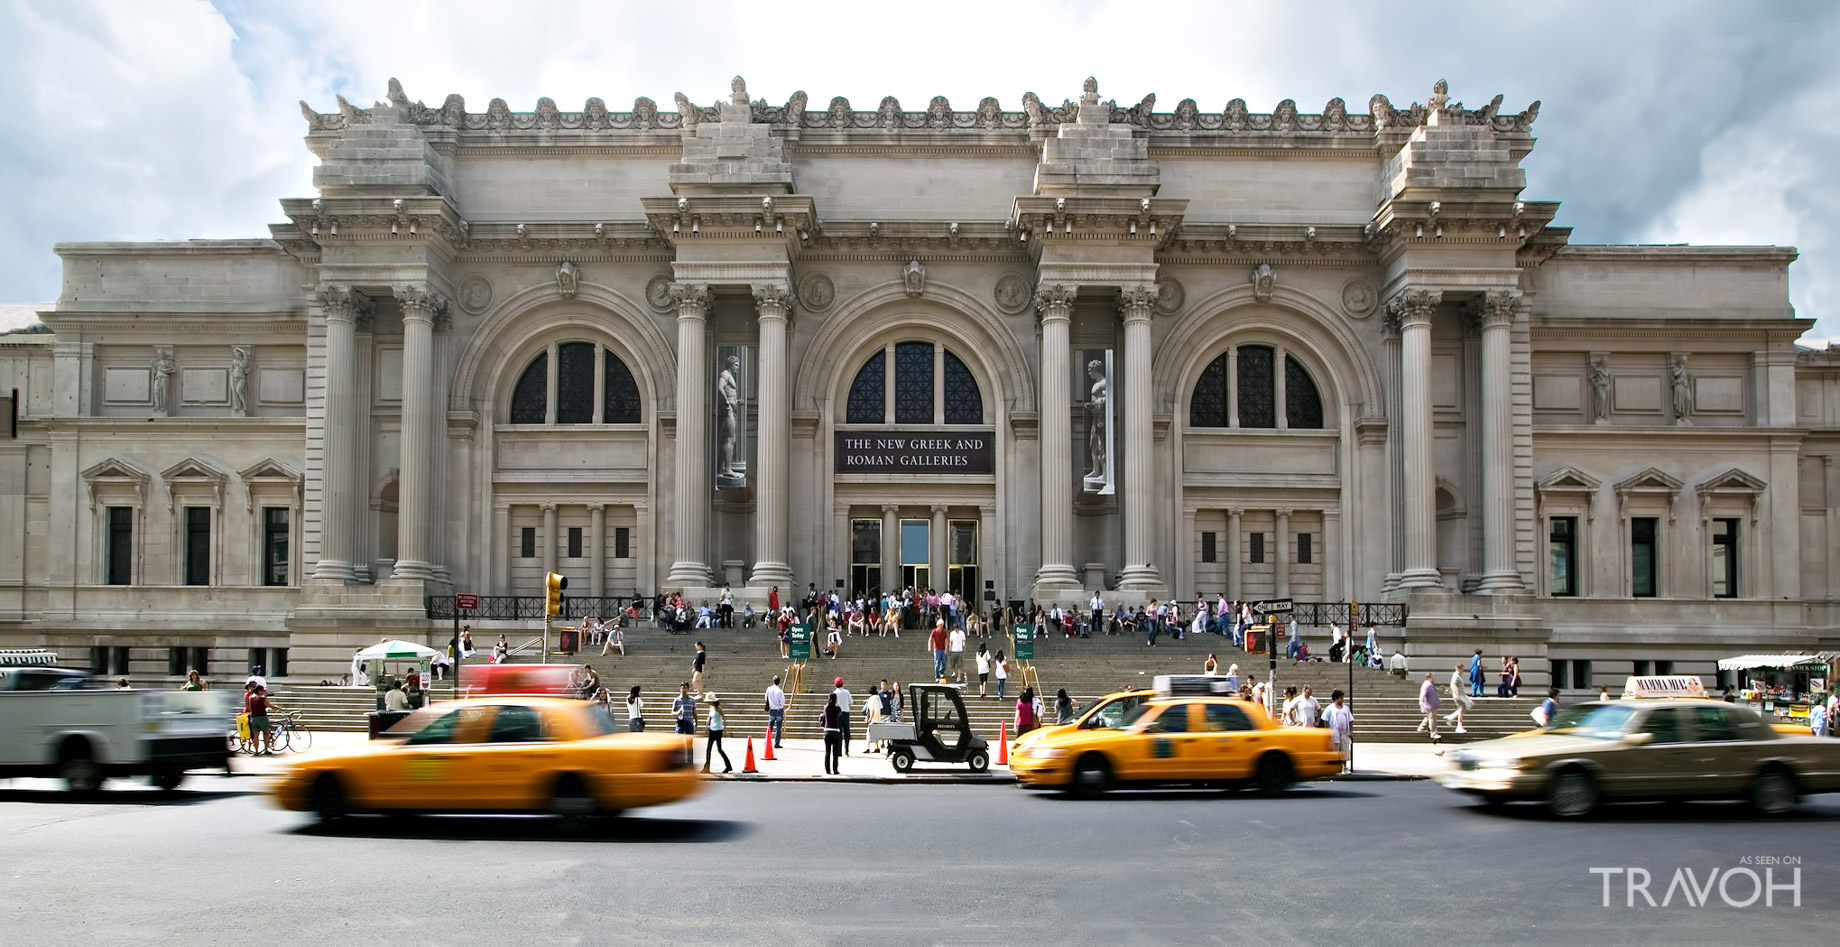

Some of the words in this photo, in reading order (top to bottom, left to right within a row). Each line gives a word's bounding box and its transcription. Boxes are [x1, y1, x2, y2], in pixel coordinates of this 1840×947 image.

[845, 439, 871, 449] THE
[877, 439, 906, 449] NEW
[910, 439, 952, 449] GREEK
[955, 439, 983, 449] AND
[847, 455, 894, 465] ROMAN
[900, 455, 968, 466] GALLERIES
[1257, 603, 1269, 611] ONE
[1636, 678, 1668, 691] MAMMA
